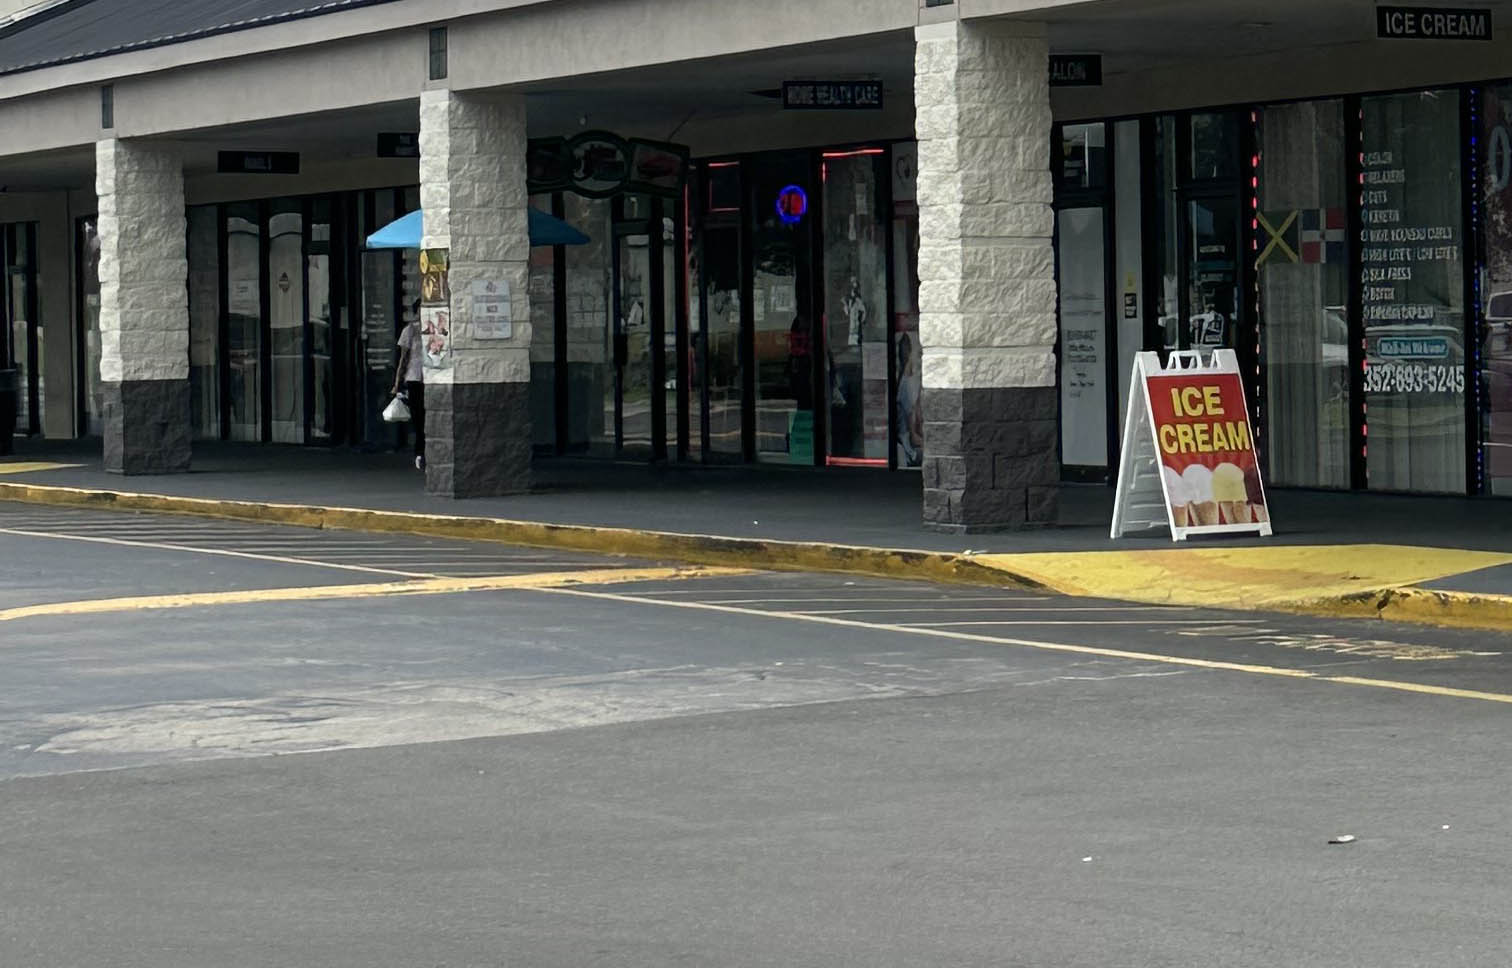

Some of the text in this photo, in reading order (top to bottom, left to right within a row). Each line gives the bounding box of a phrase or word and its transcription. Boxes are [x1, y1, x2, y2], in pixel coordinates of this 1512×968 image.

[1385, 11, 1486, 36] ICE CREAM
[1052, 60, 1087, 81] ALON
[855, 85, 879, 104] CARE
[1170, 385, 1225, 417] ICE
[1159, 420, 1251, 454] CREAM
